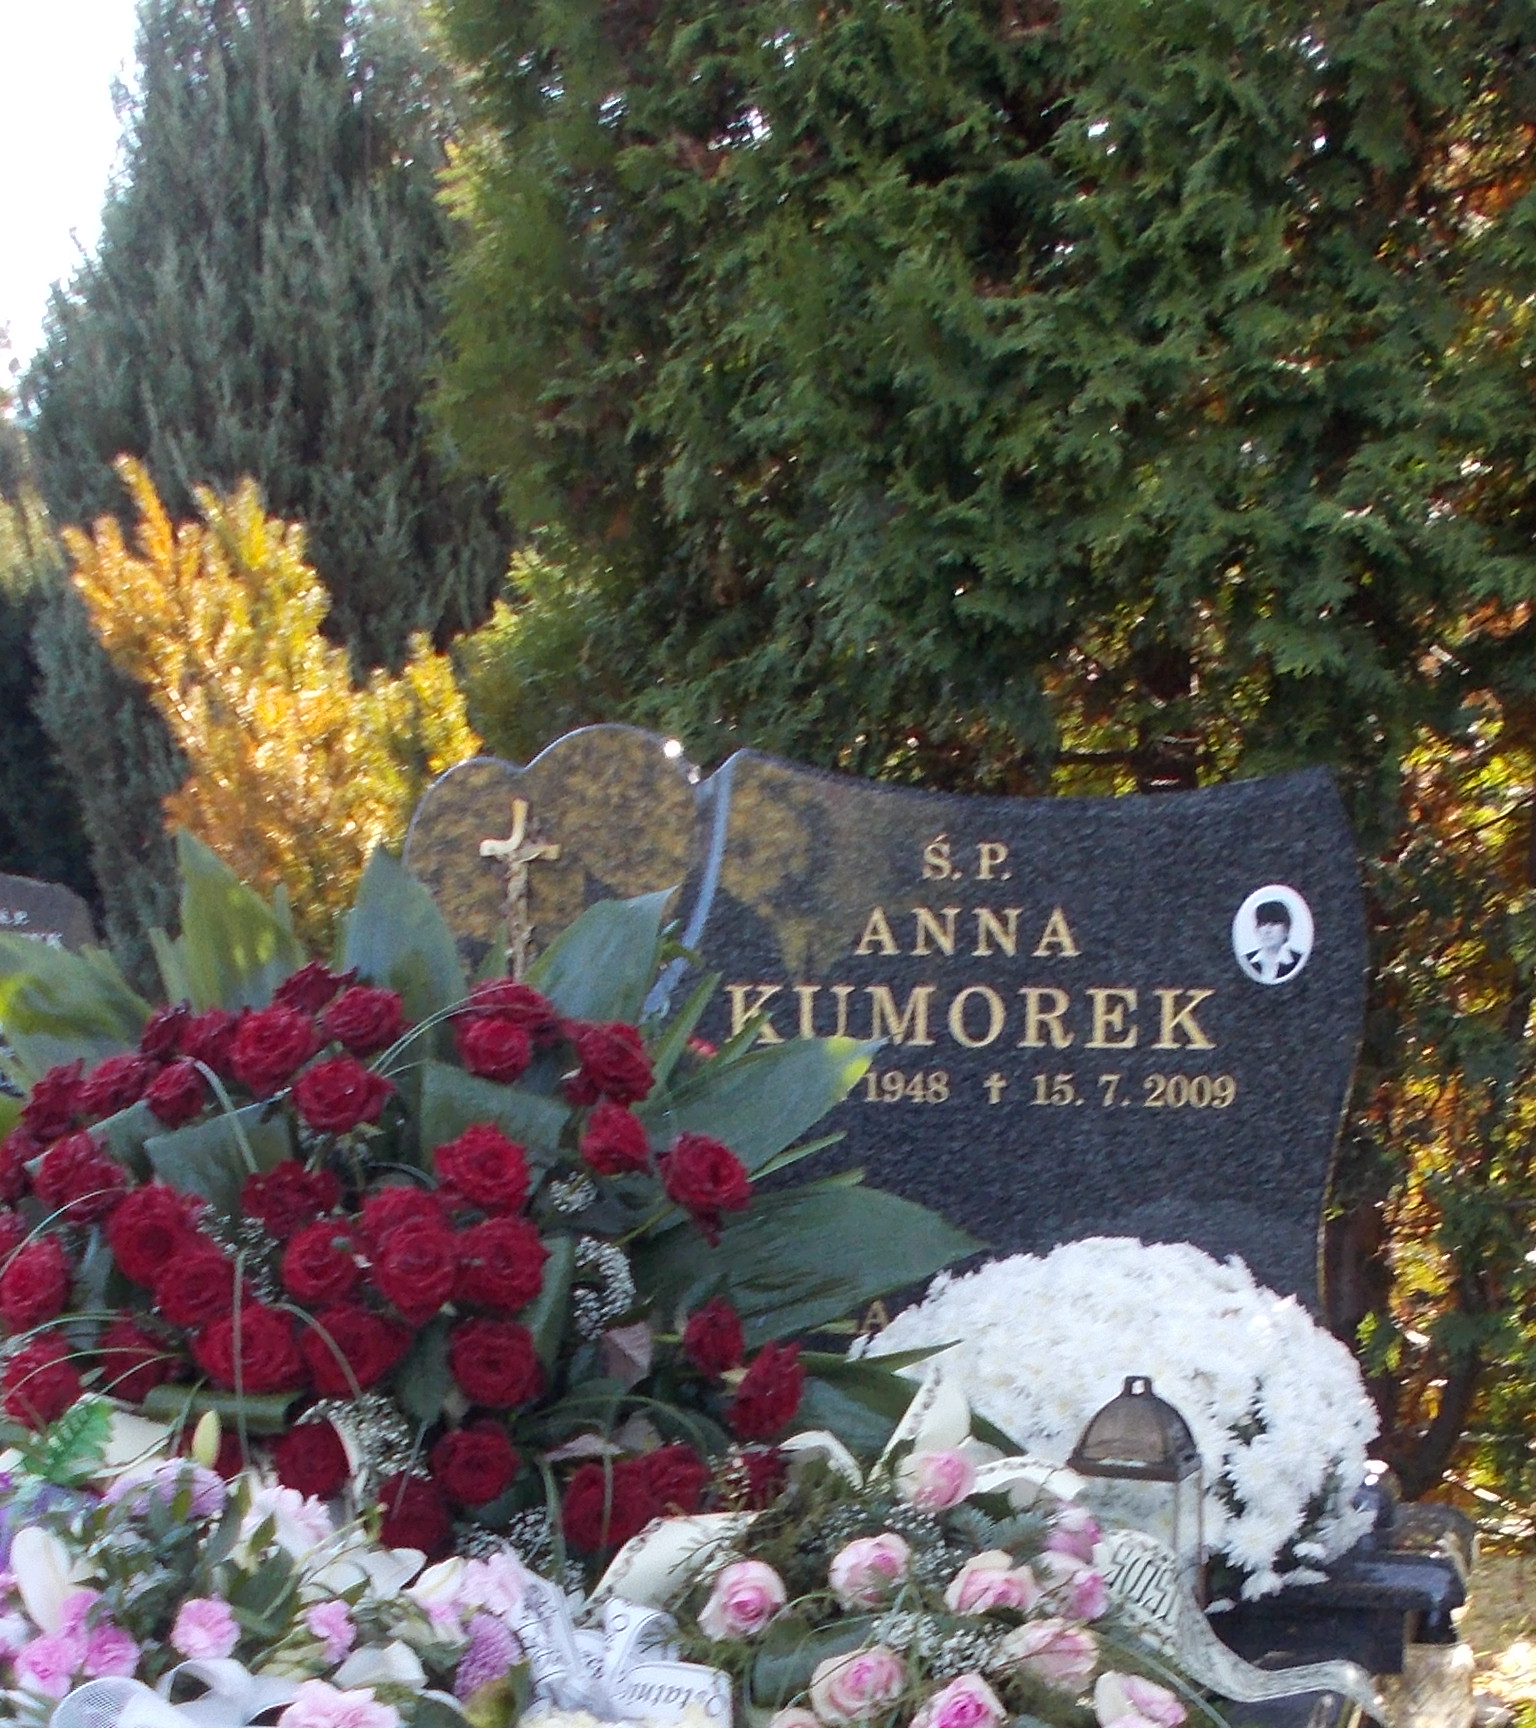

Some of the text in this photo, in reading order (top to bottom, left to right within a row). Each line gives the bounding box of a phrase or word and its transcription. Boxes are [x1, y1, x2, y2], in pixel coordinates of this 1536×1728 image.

[855, 906, 1082, 958] ANNA
[724, 982, 1217, 1050] KUMOREK
[865, 1071, 951, 1103] 1948
[1143, 1074, 1237, 1109] 2009
